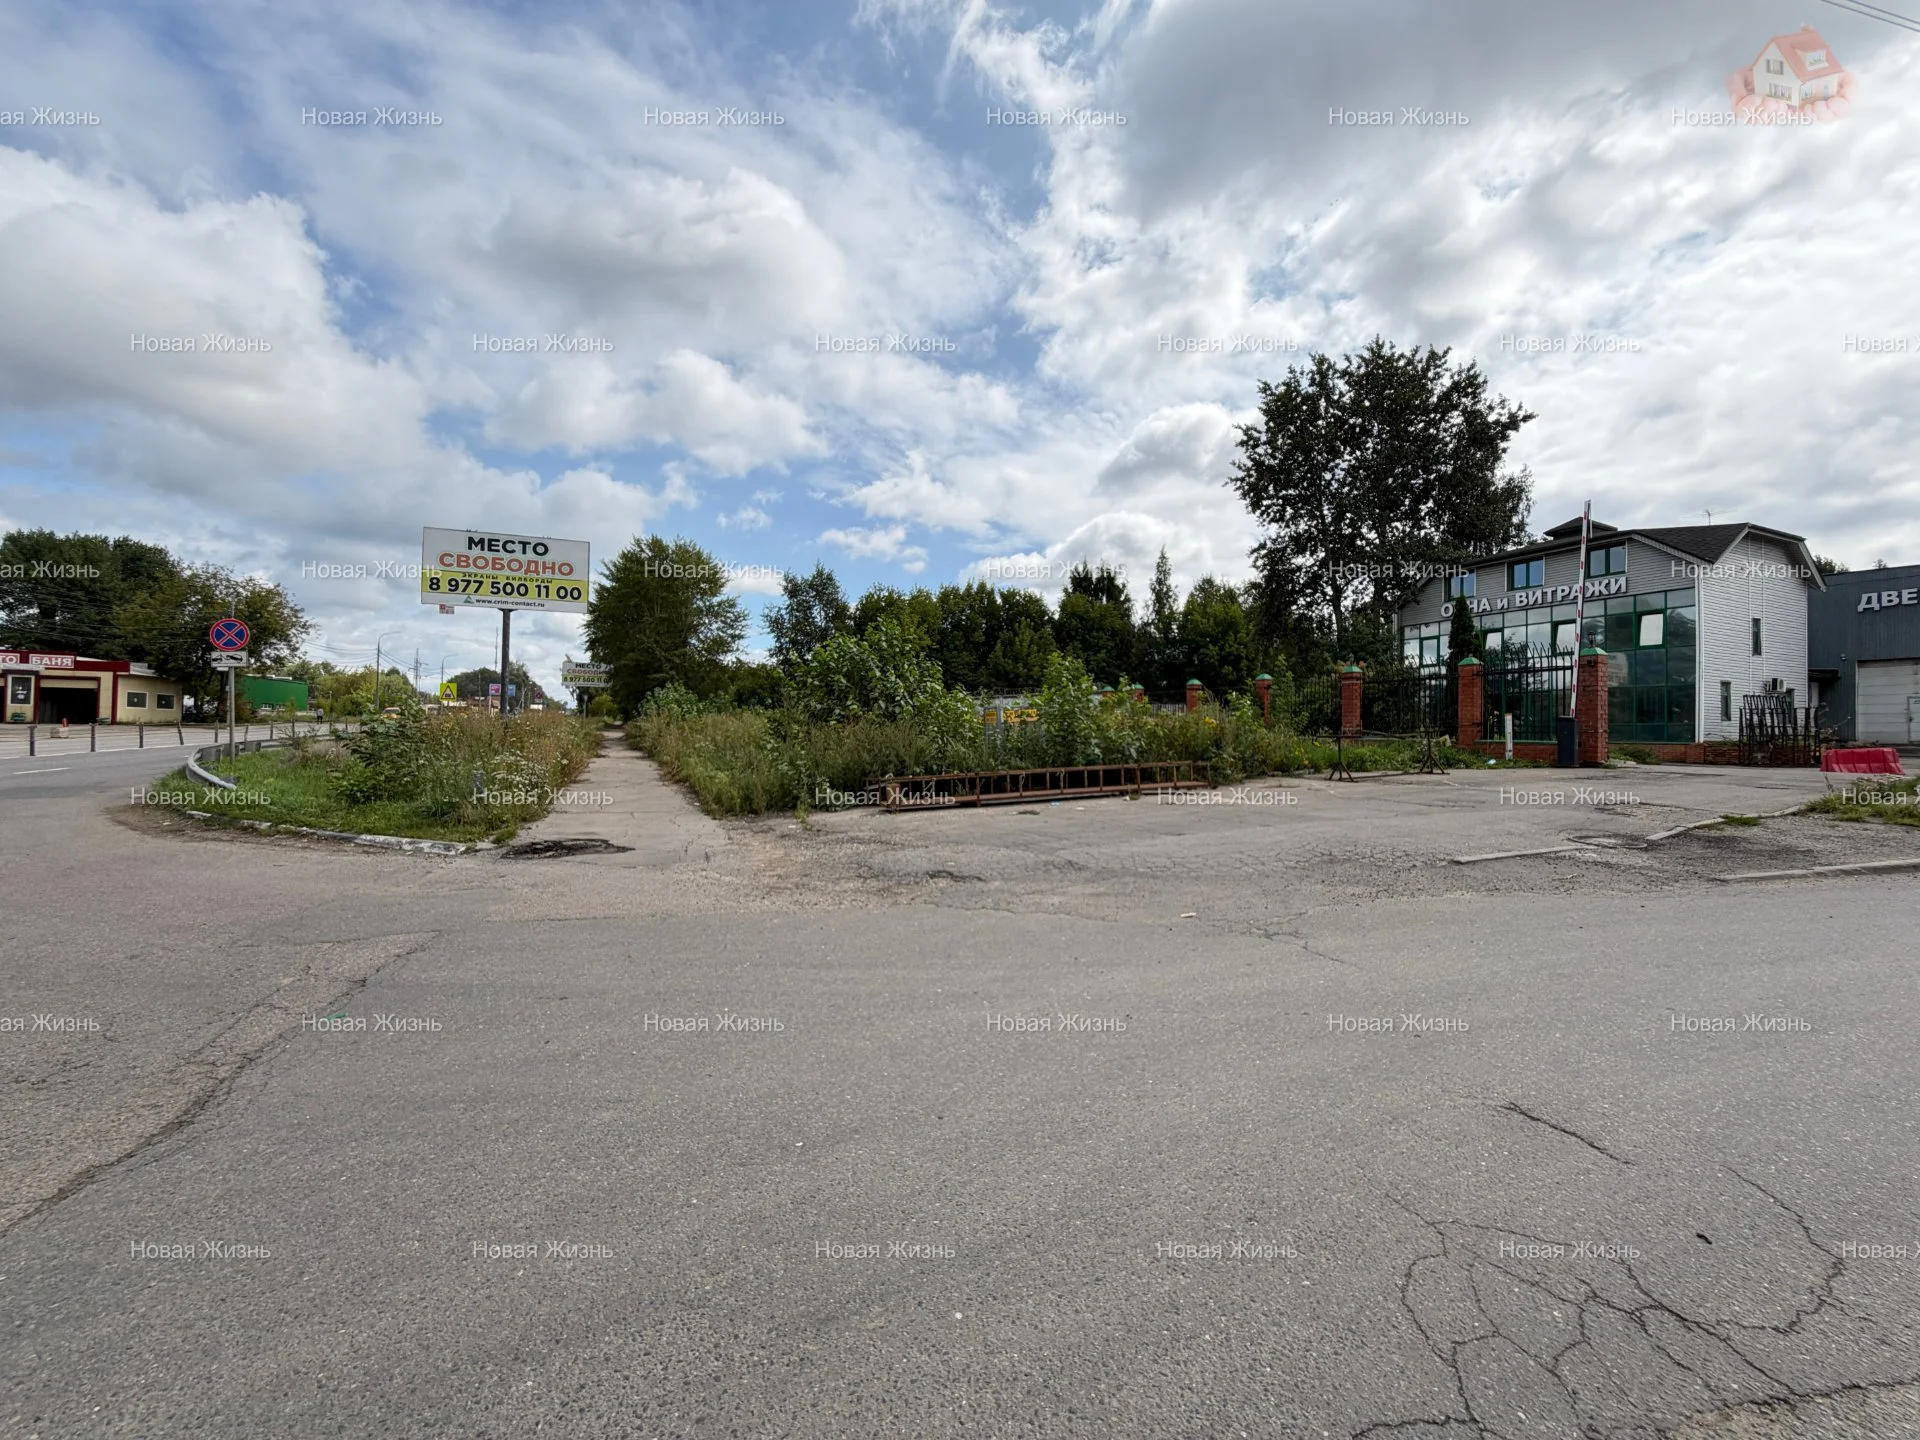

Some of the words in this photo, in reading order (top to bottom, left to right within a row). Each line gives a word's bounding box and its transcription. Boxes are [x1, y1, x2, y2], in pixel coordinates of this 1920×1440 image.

[467, 536, 549, 556] МЕСТО
[438, 552, 574, 577] СВОБОДНО
[462, 572, 499, 580] ЭКРАНЫ
[428, 577, 441, 591] 8
[447, 578, 484, 594] 977
[489, 581, 529, 597] 500
[535, 584, 550, 598] 11
[556, 586, 582, 601] 00
[1440, 598, 1492, 618] ОНА
[1515, 576, 1627, 607] ВИТРАЖИ
[1857, 587, 1918, 612] ДВЕ
[31, 656, 72, 666] БАНЯ
